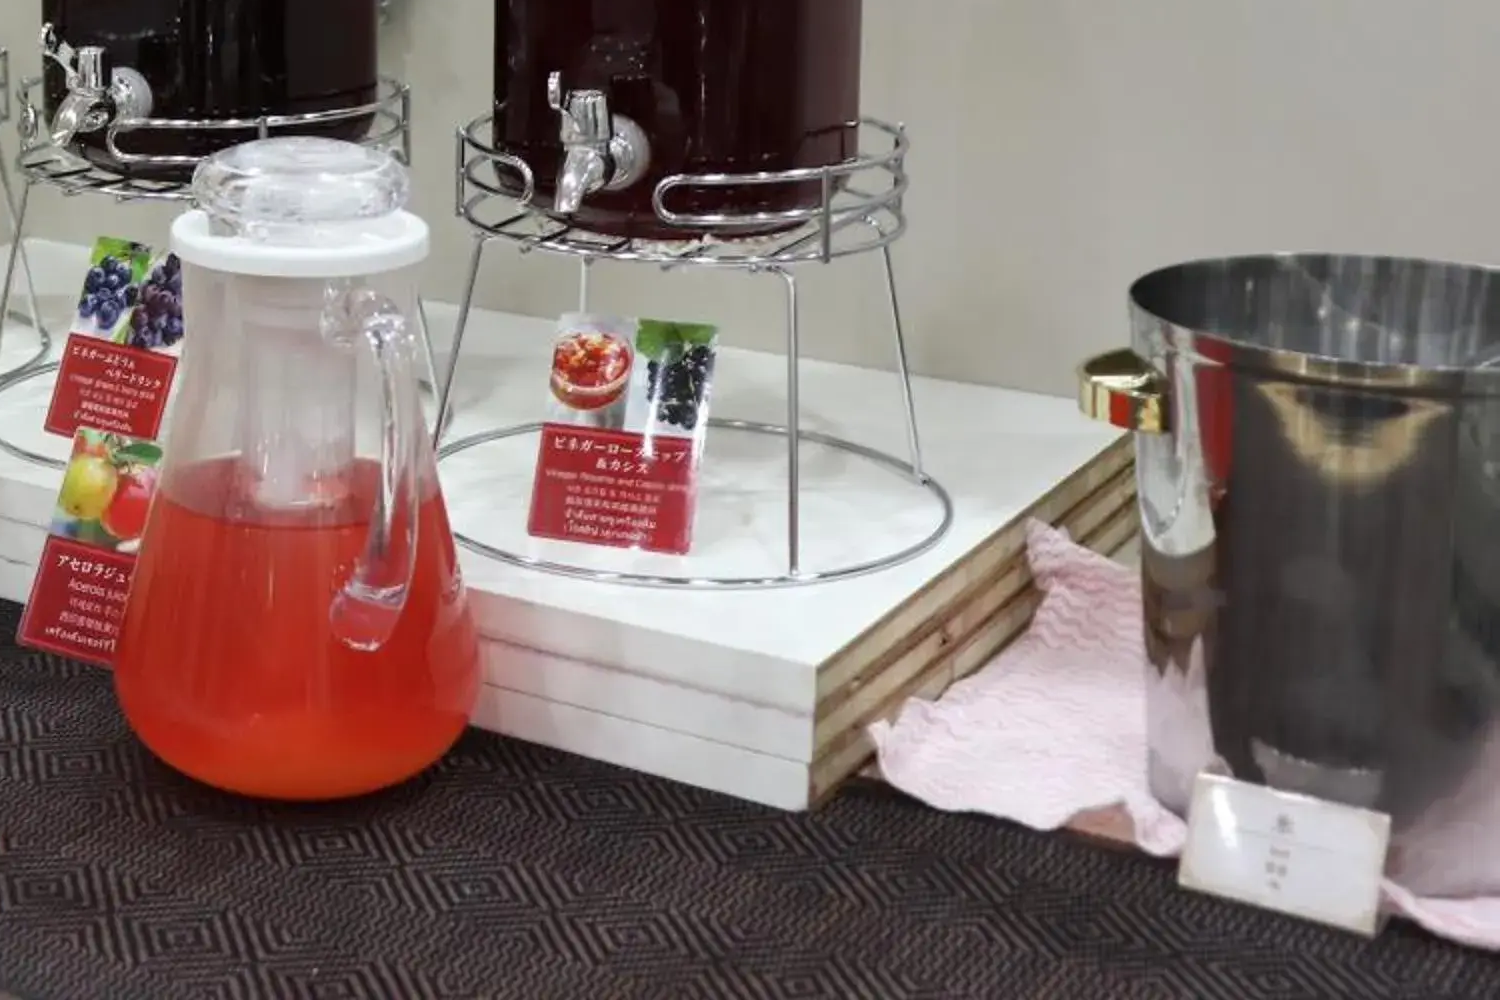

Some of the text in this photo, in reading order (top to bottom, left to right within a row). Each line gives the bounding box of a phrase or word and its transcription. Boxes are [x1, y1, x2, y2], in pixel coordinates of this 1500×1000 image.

[57, 555, 127, 583] アセロラジュ
